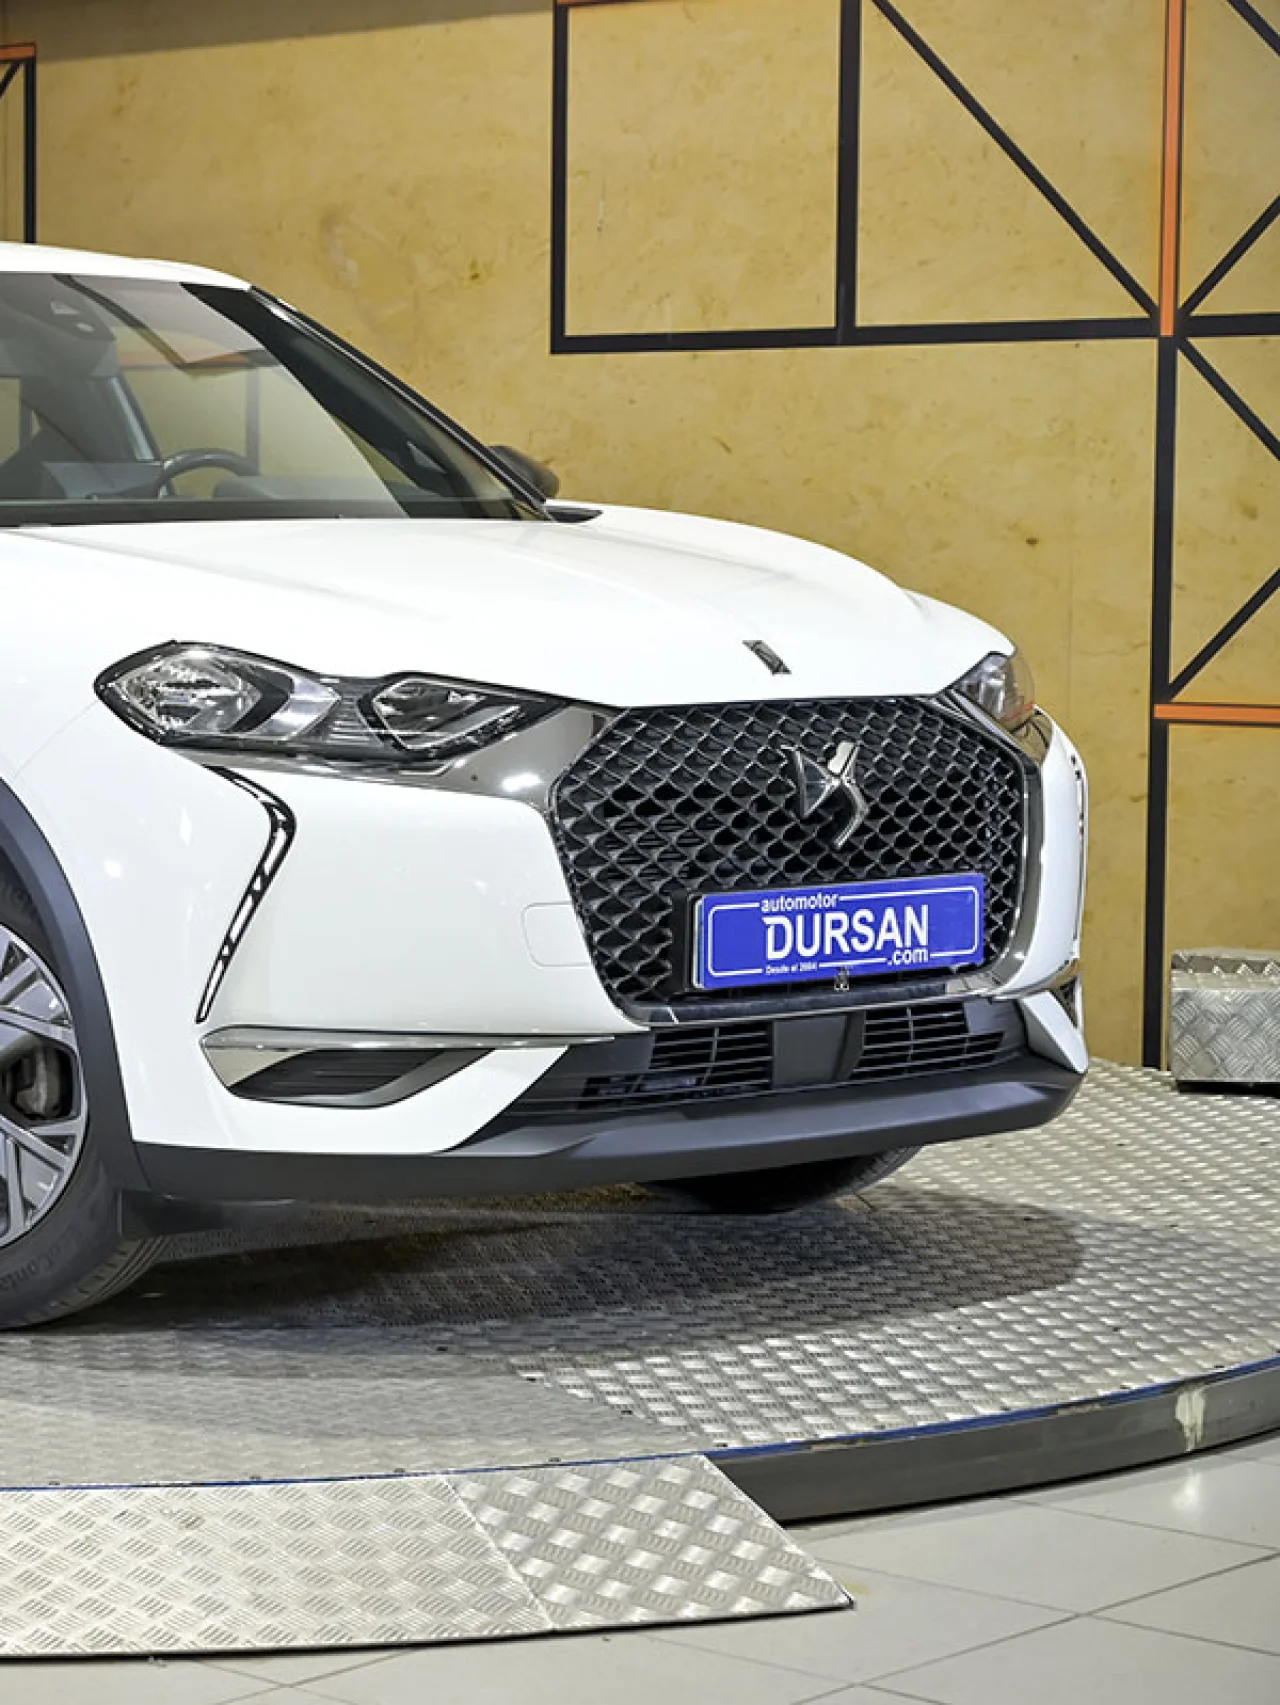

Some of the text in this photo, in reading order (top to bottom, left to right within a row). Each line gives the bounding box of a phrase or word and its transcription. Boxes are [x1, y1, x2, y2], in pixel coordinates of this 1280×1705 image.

[761, 891, 839, 912] automotor
[762, 904, 929, 961] DURSAN
[886, 947, 929, 966] .com
